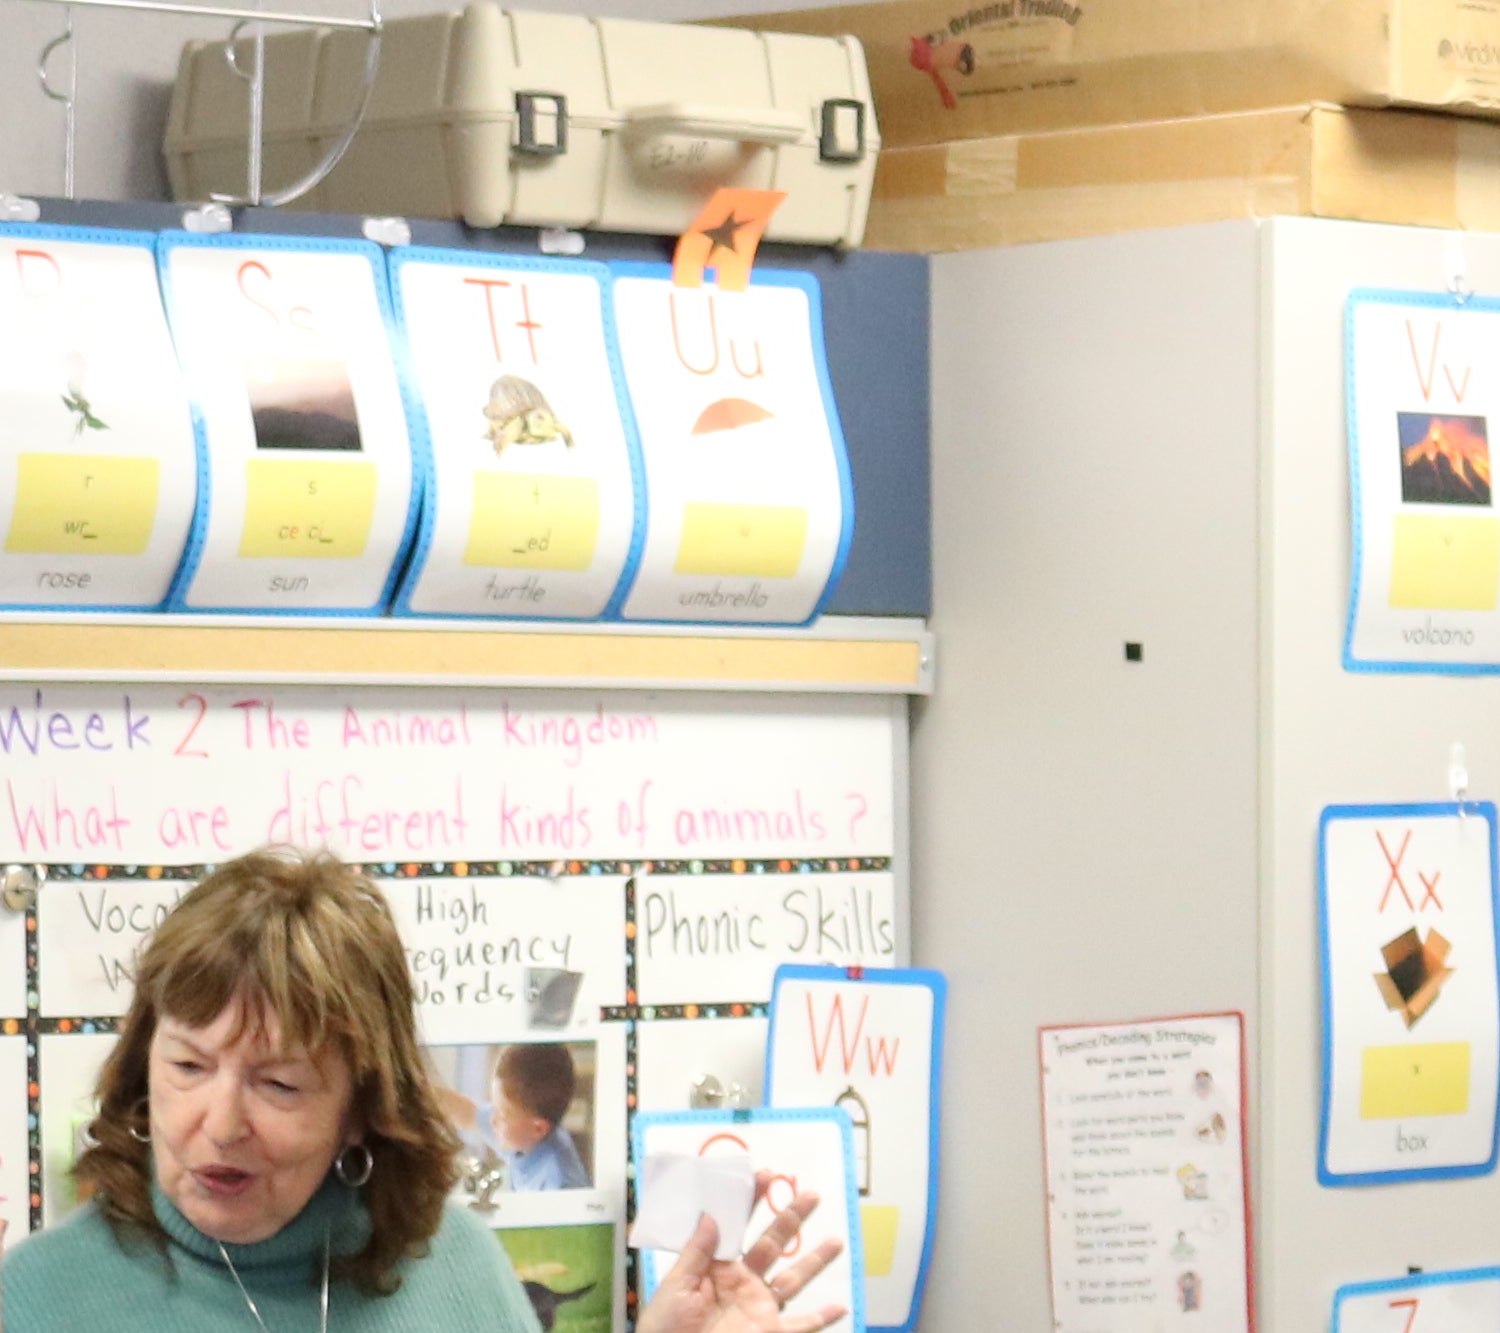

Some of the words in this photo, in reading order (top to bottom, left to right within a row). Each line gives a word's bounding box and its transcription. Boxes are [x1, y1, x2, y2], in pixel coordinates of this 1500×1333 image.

[35, 569, 92, 590] rose
[269, 573, 309, 594] sun
[484, 578, 547, 603] turtle
[1402, 617, 1475, 646] volcano
[230, 697, 311, 751] The
[341, 702, 472, 750] Animal
[6, 776, 131, 853] What
[158, 799, 231, 853] are
[264, 765, 470, 856] different
[615, 777, 657, 849] of
[672, 788, 828, 848] animals
[415, 883, 489, 934] High
[643, 887, 769, 961] Phonic
[781, 887, 896, 959] Skills
[1394, 1125, 1429, 1153] box
